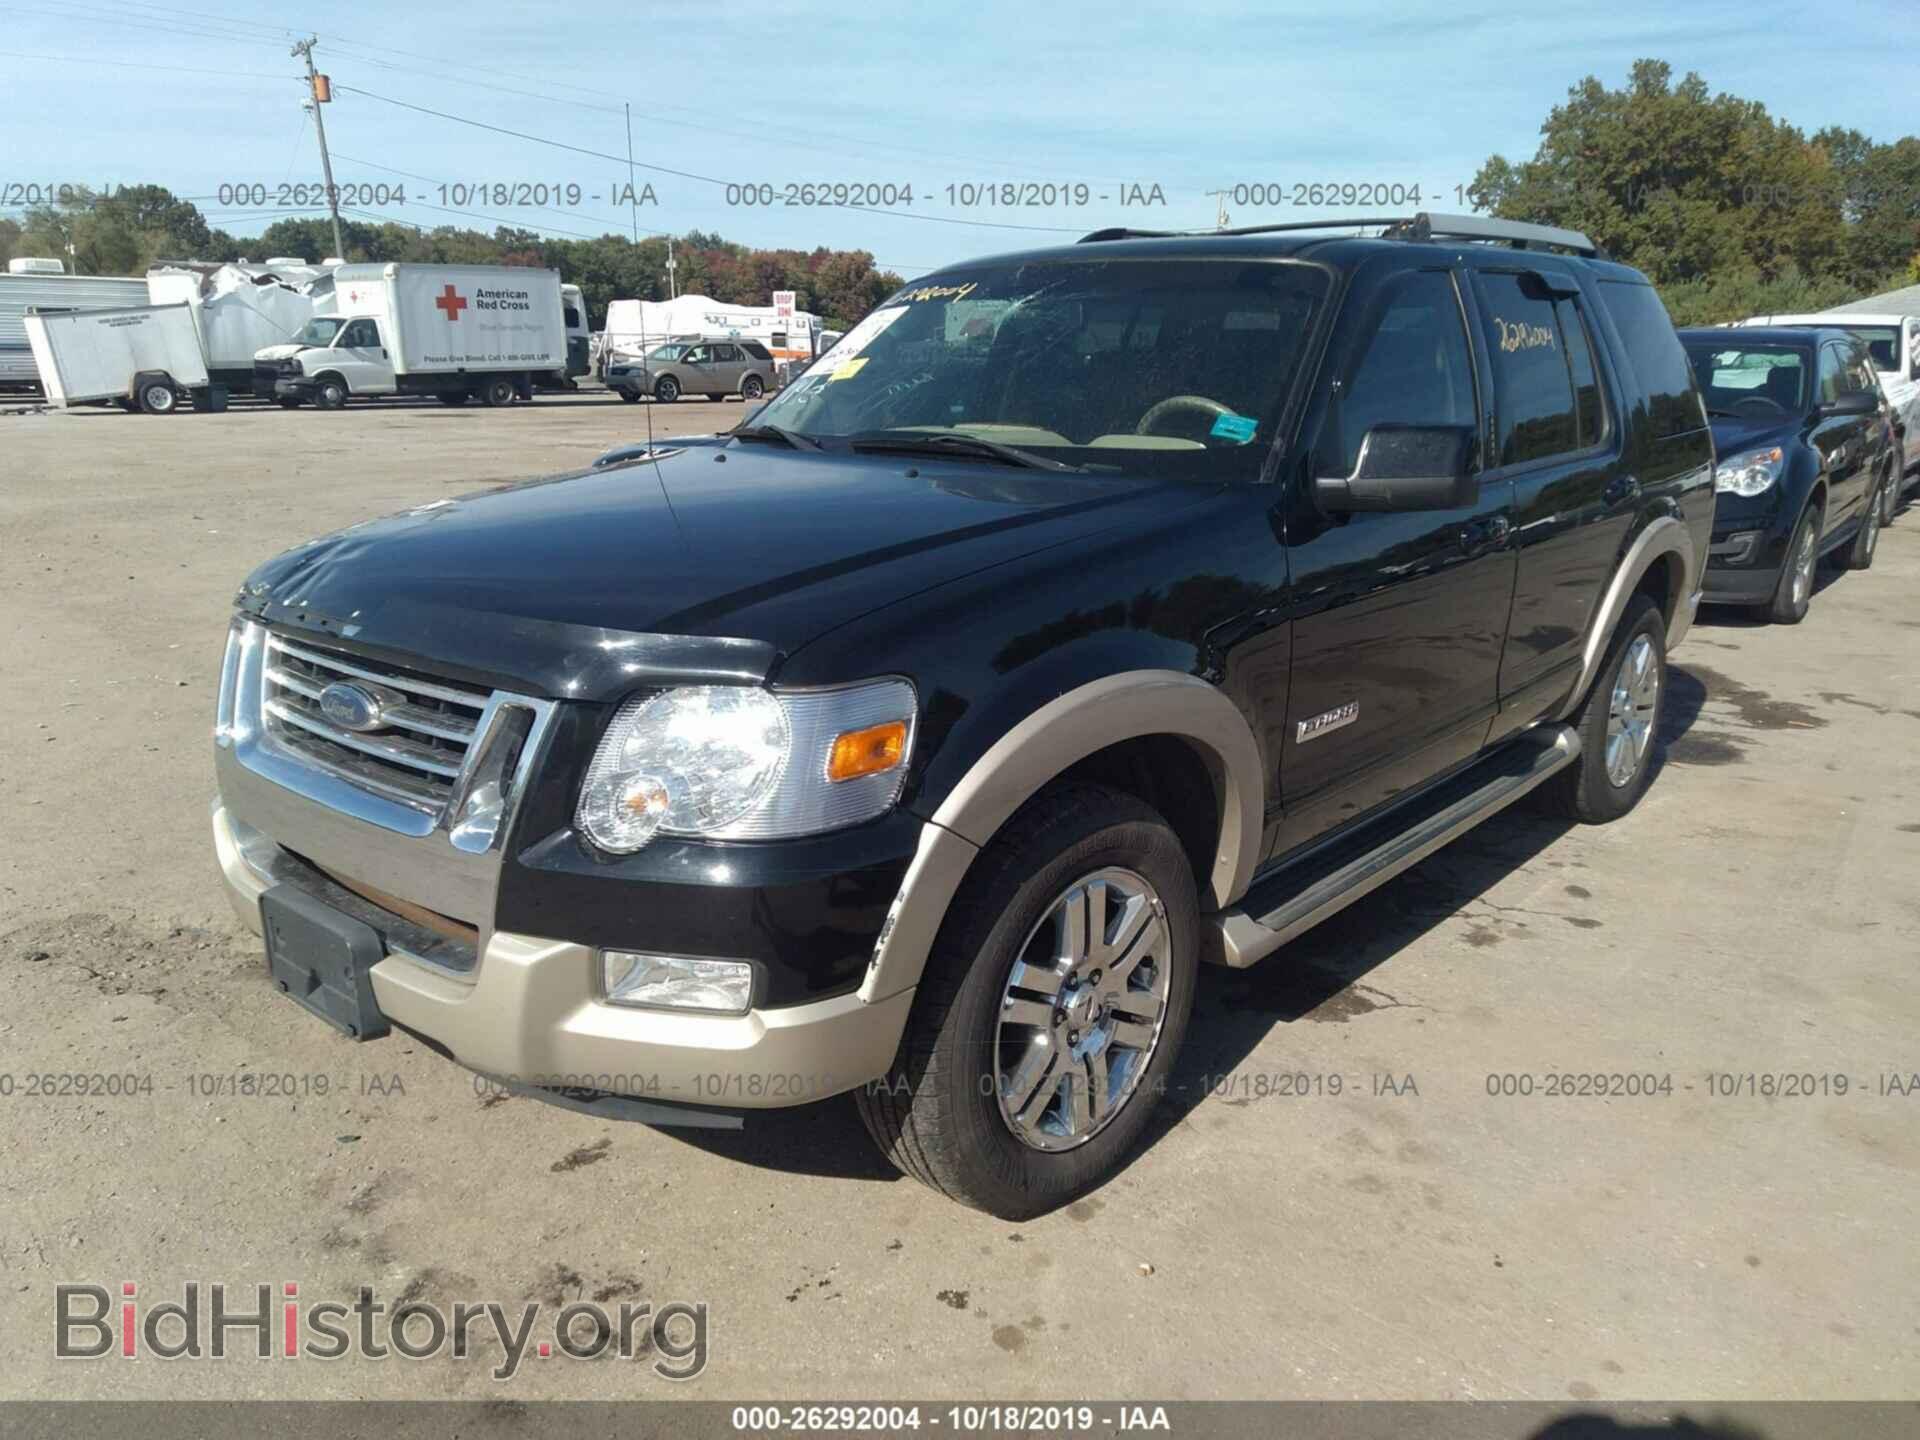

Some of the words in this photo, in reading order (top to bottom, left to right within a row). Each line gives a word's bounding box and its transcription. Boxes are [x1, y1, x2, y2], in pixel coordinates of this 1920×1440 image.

[476, 288, 528, 299] American
[476, 300, 497, 310] Red
[499, 300, 530, 311] Cross
